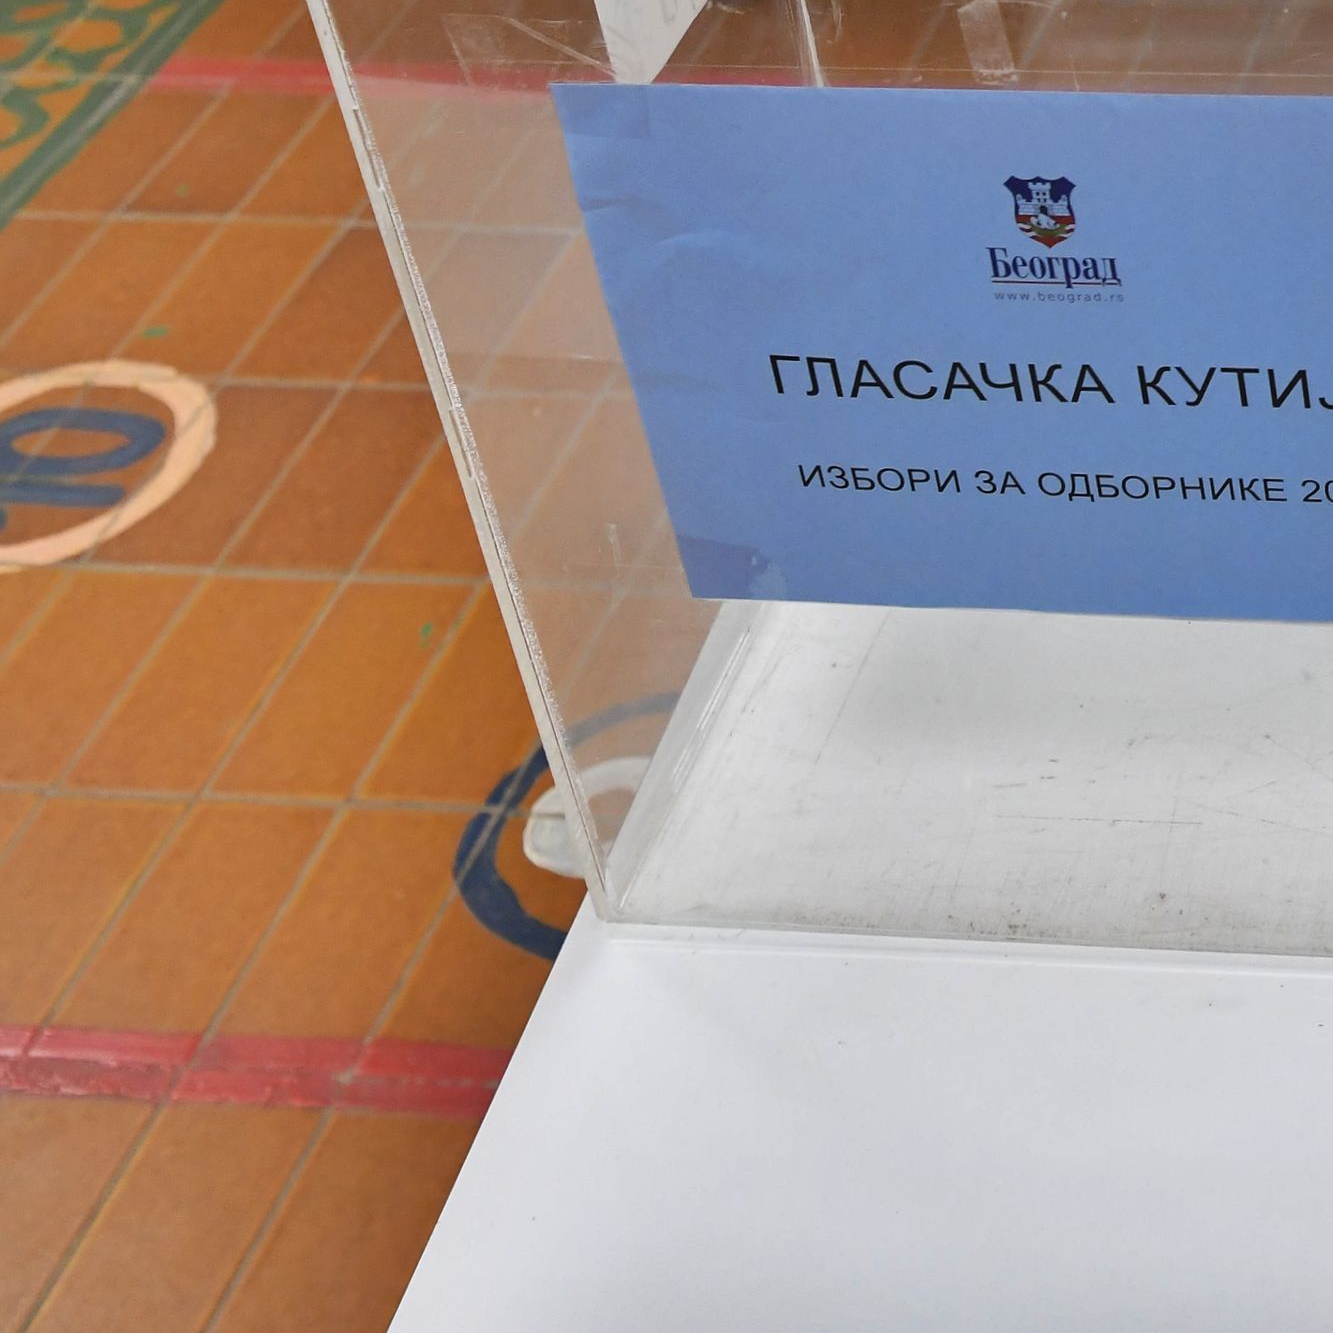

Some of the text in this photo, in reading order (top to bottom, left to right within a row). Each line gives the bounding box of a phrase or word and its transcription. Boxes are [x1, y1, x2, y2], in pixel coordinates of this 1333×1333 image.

[986, 246, 1121, 288] Београд
[994, 291, 1125, 304] www.beograd.rs
[769, 354, 1115, 404] ГЛАСАЧКА
[798, 464, 961, 494] ИЗБОРИ
[974, 469, 1026, 495] ЗА
[1037, 472, 1288, 503] ОДБОРНИКЕ
